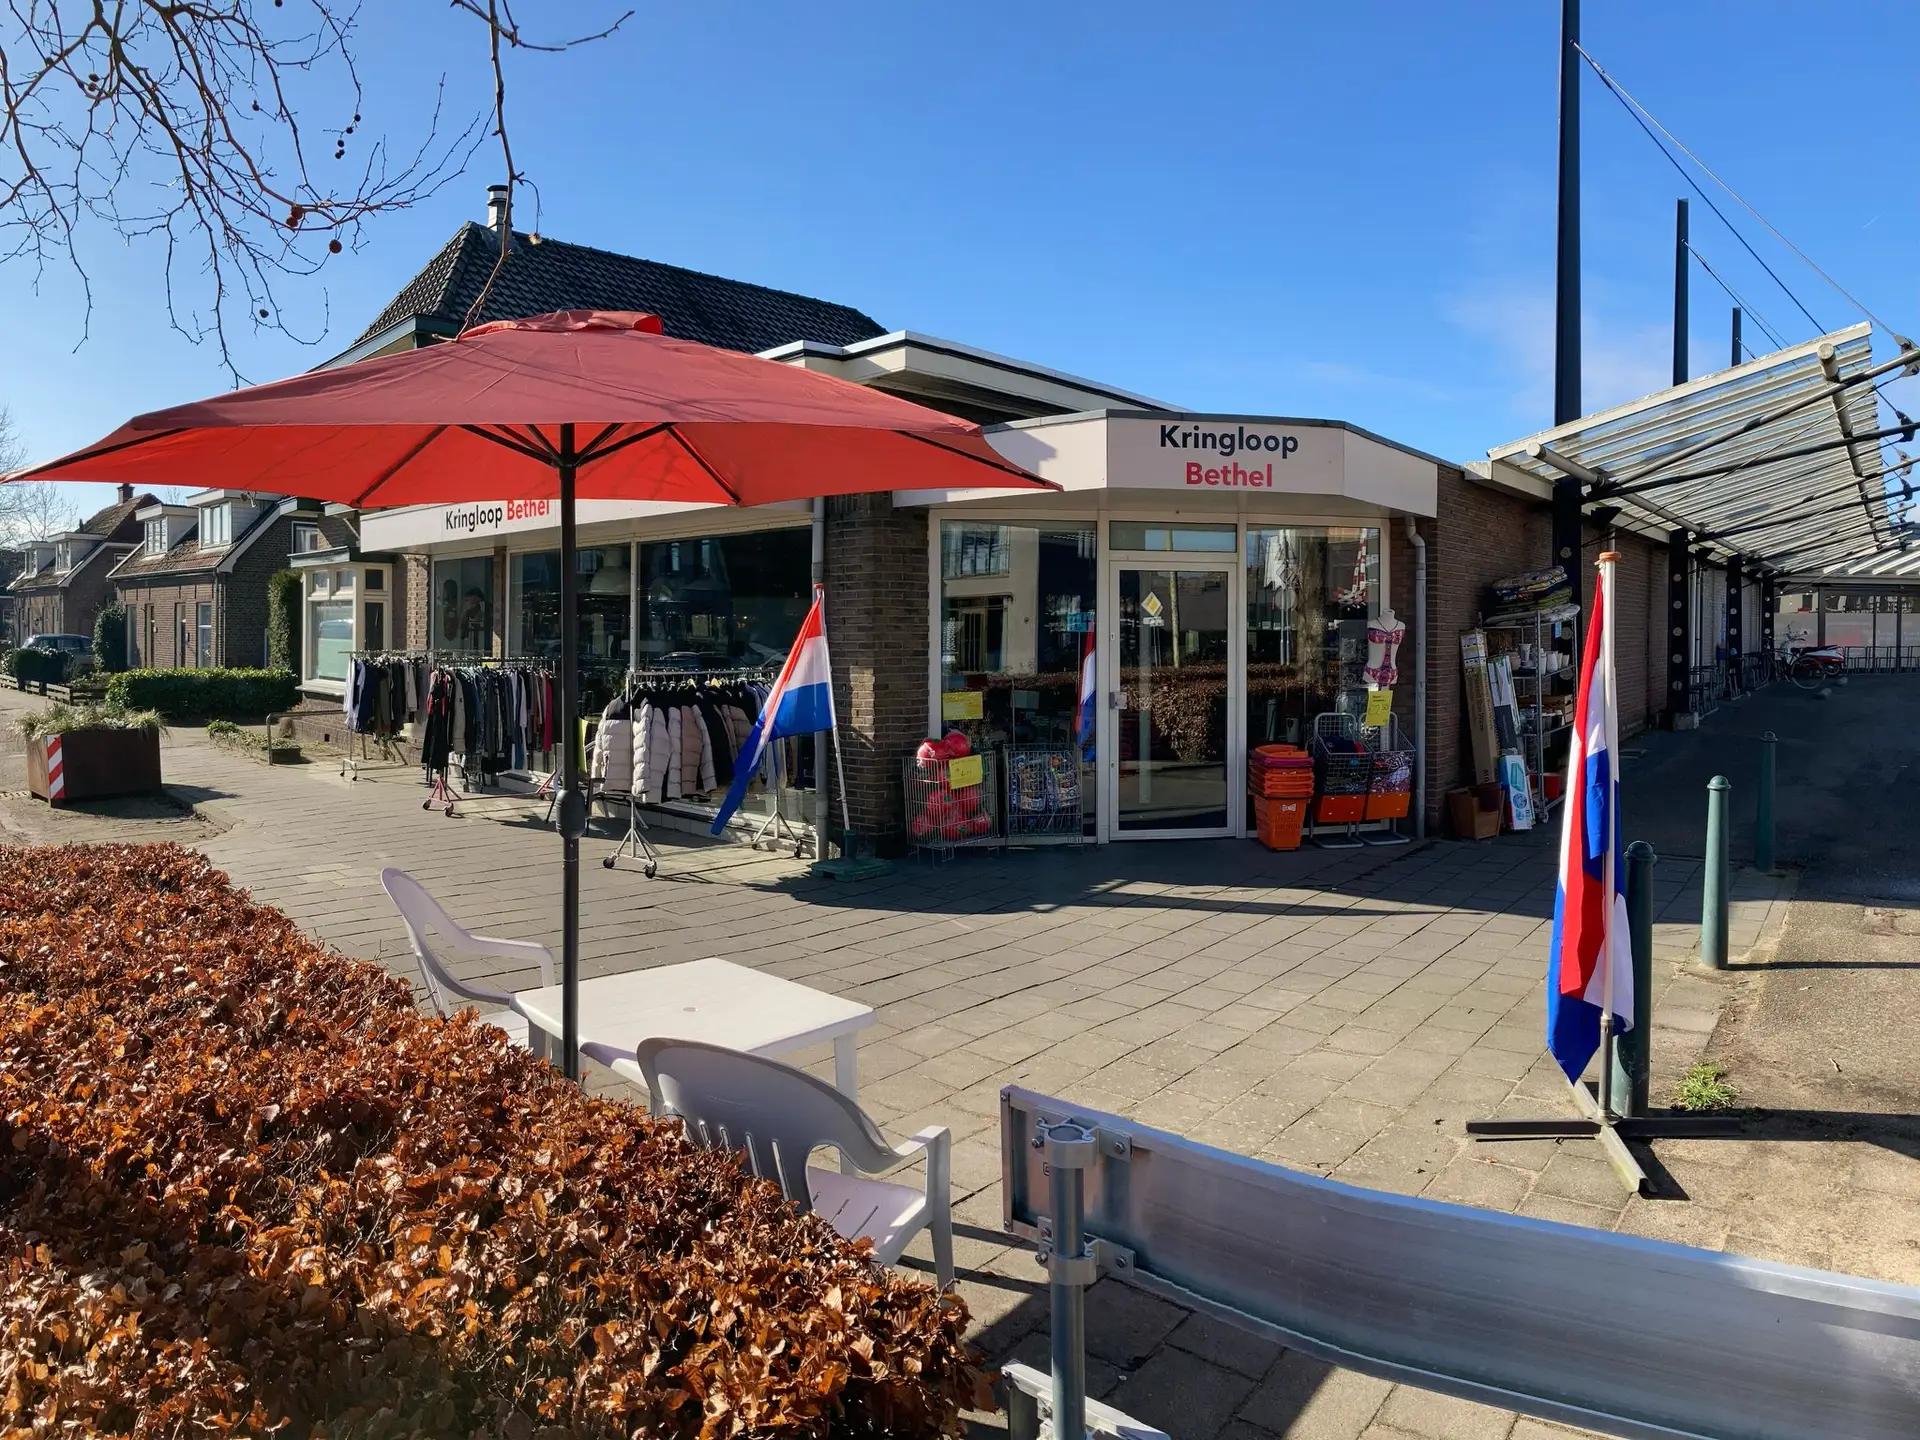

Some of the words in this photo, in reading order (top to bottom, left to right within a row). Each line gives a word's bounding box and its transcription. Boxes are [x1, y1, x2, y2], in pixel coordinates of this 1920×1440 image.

[1160, 424, 1299, 459] Kringloop
[1186, 462, 1273, 488] Bethel
[446, 504, 503, 532] Kringloop
[506, 500, 550, 521] Bethel
